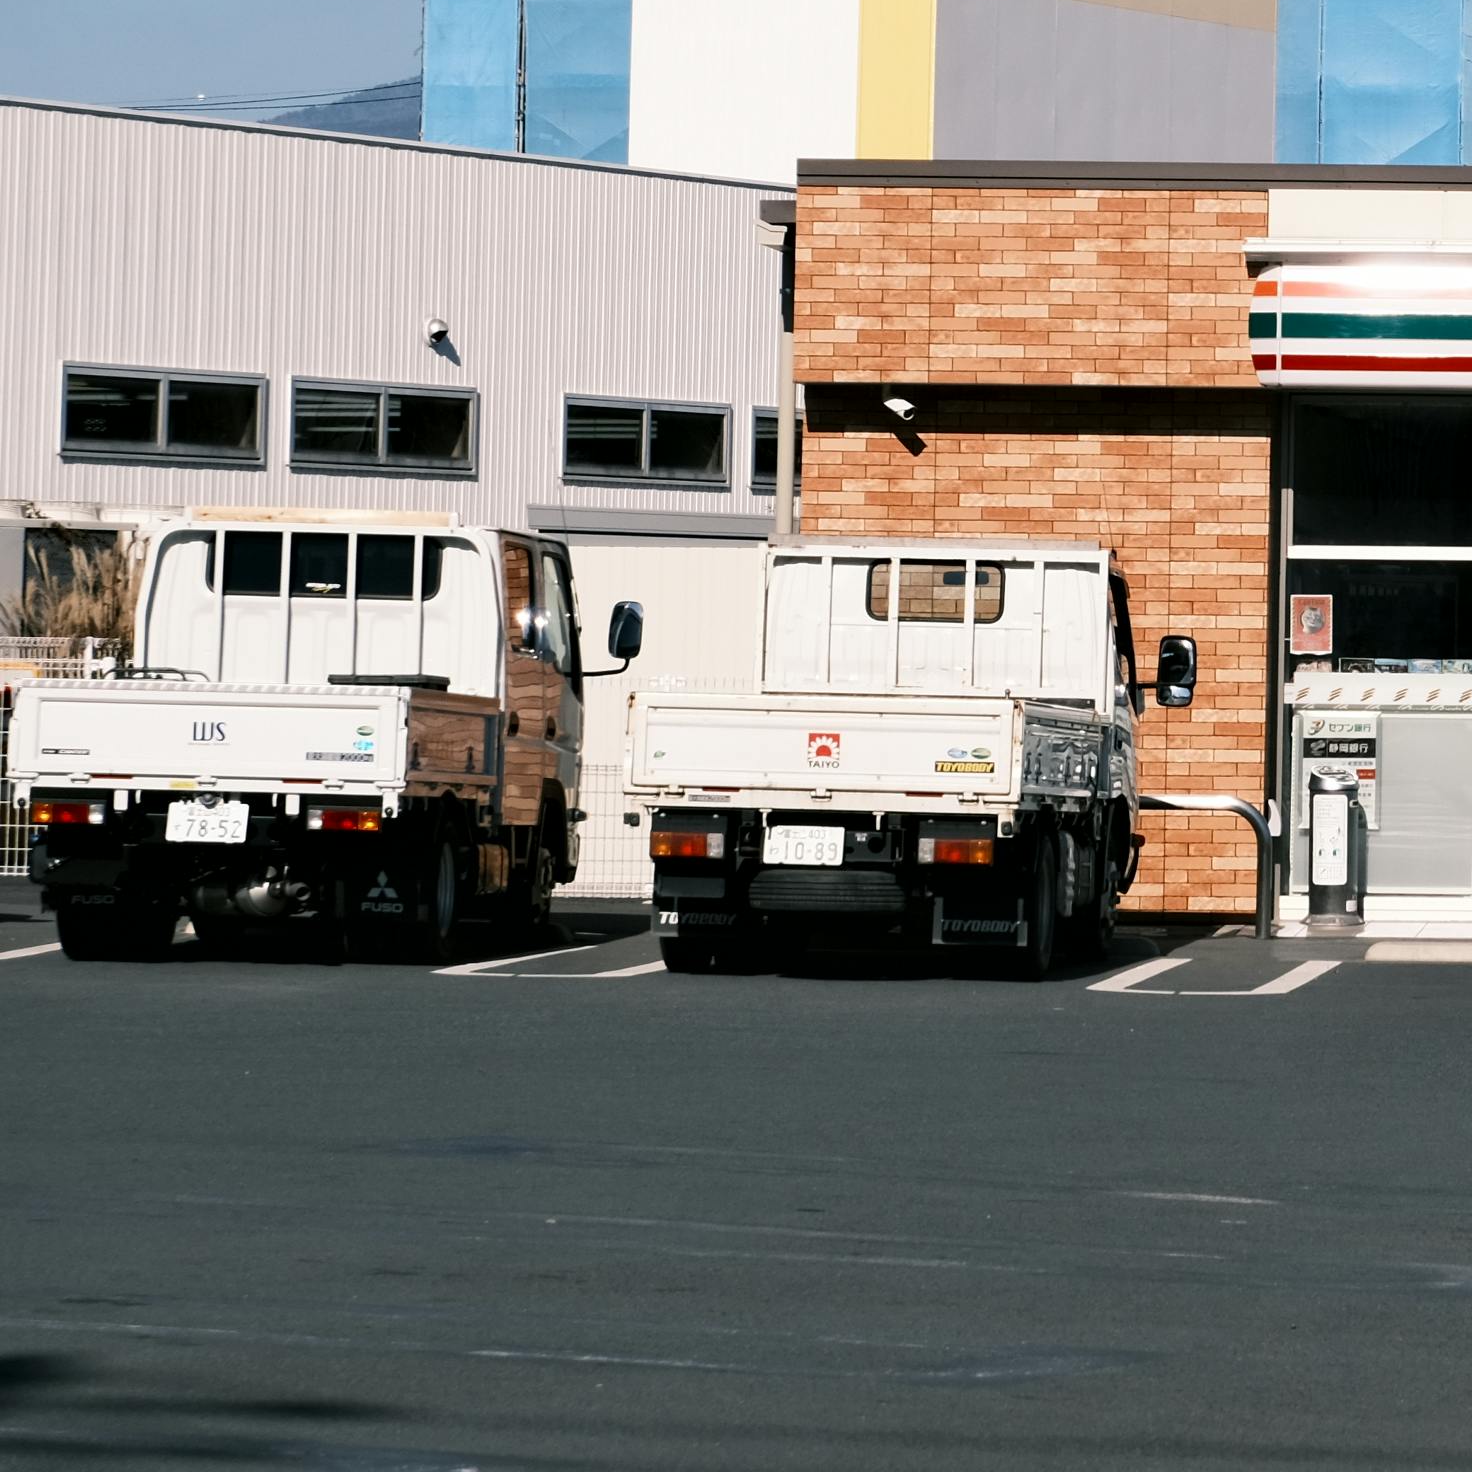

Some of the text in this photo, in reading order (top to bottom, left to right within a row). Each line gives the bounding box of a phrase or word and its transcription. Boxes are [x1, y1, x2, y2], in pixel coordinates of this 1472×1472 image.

[1329, 723, 1371, 732] セブン銀行
[808, 760, 839, 768] TAIYO
[935, 761, 995, 772] TOYOBODY
[186, 819, 241, 838] 78-52
[784, 841, 838, 861] 10-89
[71, 895, 115, 905] FUSO
[361, 902, 404, 913] FUSO
[658, 911, 737, 925] TOYOBODY
[942, 919, 1018, 933] TOYOBODY
